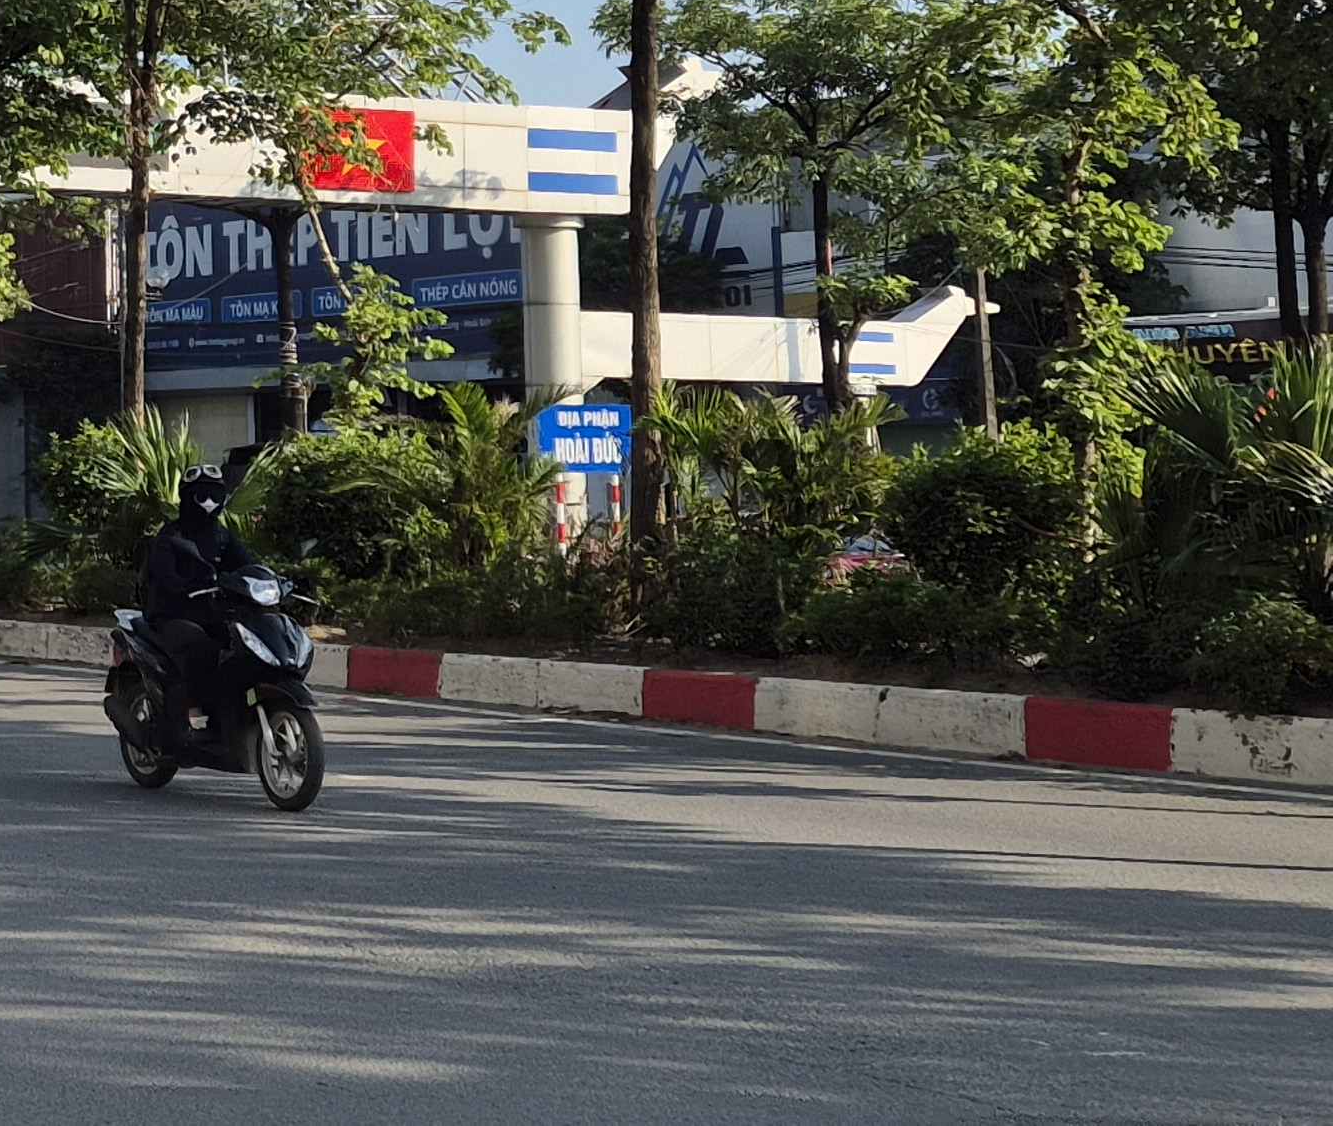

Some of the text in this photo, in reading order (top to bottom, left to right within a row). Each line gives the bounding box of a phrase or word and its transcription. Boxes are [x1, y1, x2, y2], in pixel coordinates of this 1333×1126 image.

[318, 291, 341, 310] TÔN
[420, 282, 449, 302] THÉP
[479, 277, 518, 298] NÓNG
[229, 299, 252, 317] TÔN
[556, 408, 620, 430] ĐỊA PHẬN
[554, 430, 623, 464] HOÀI ĐỨC
